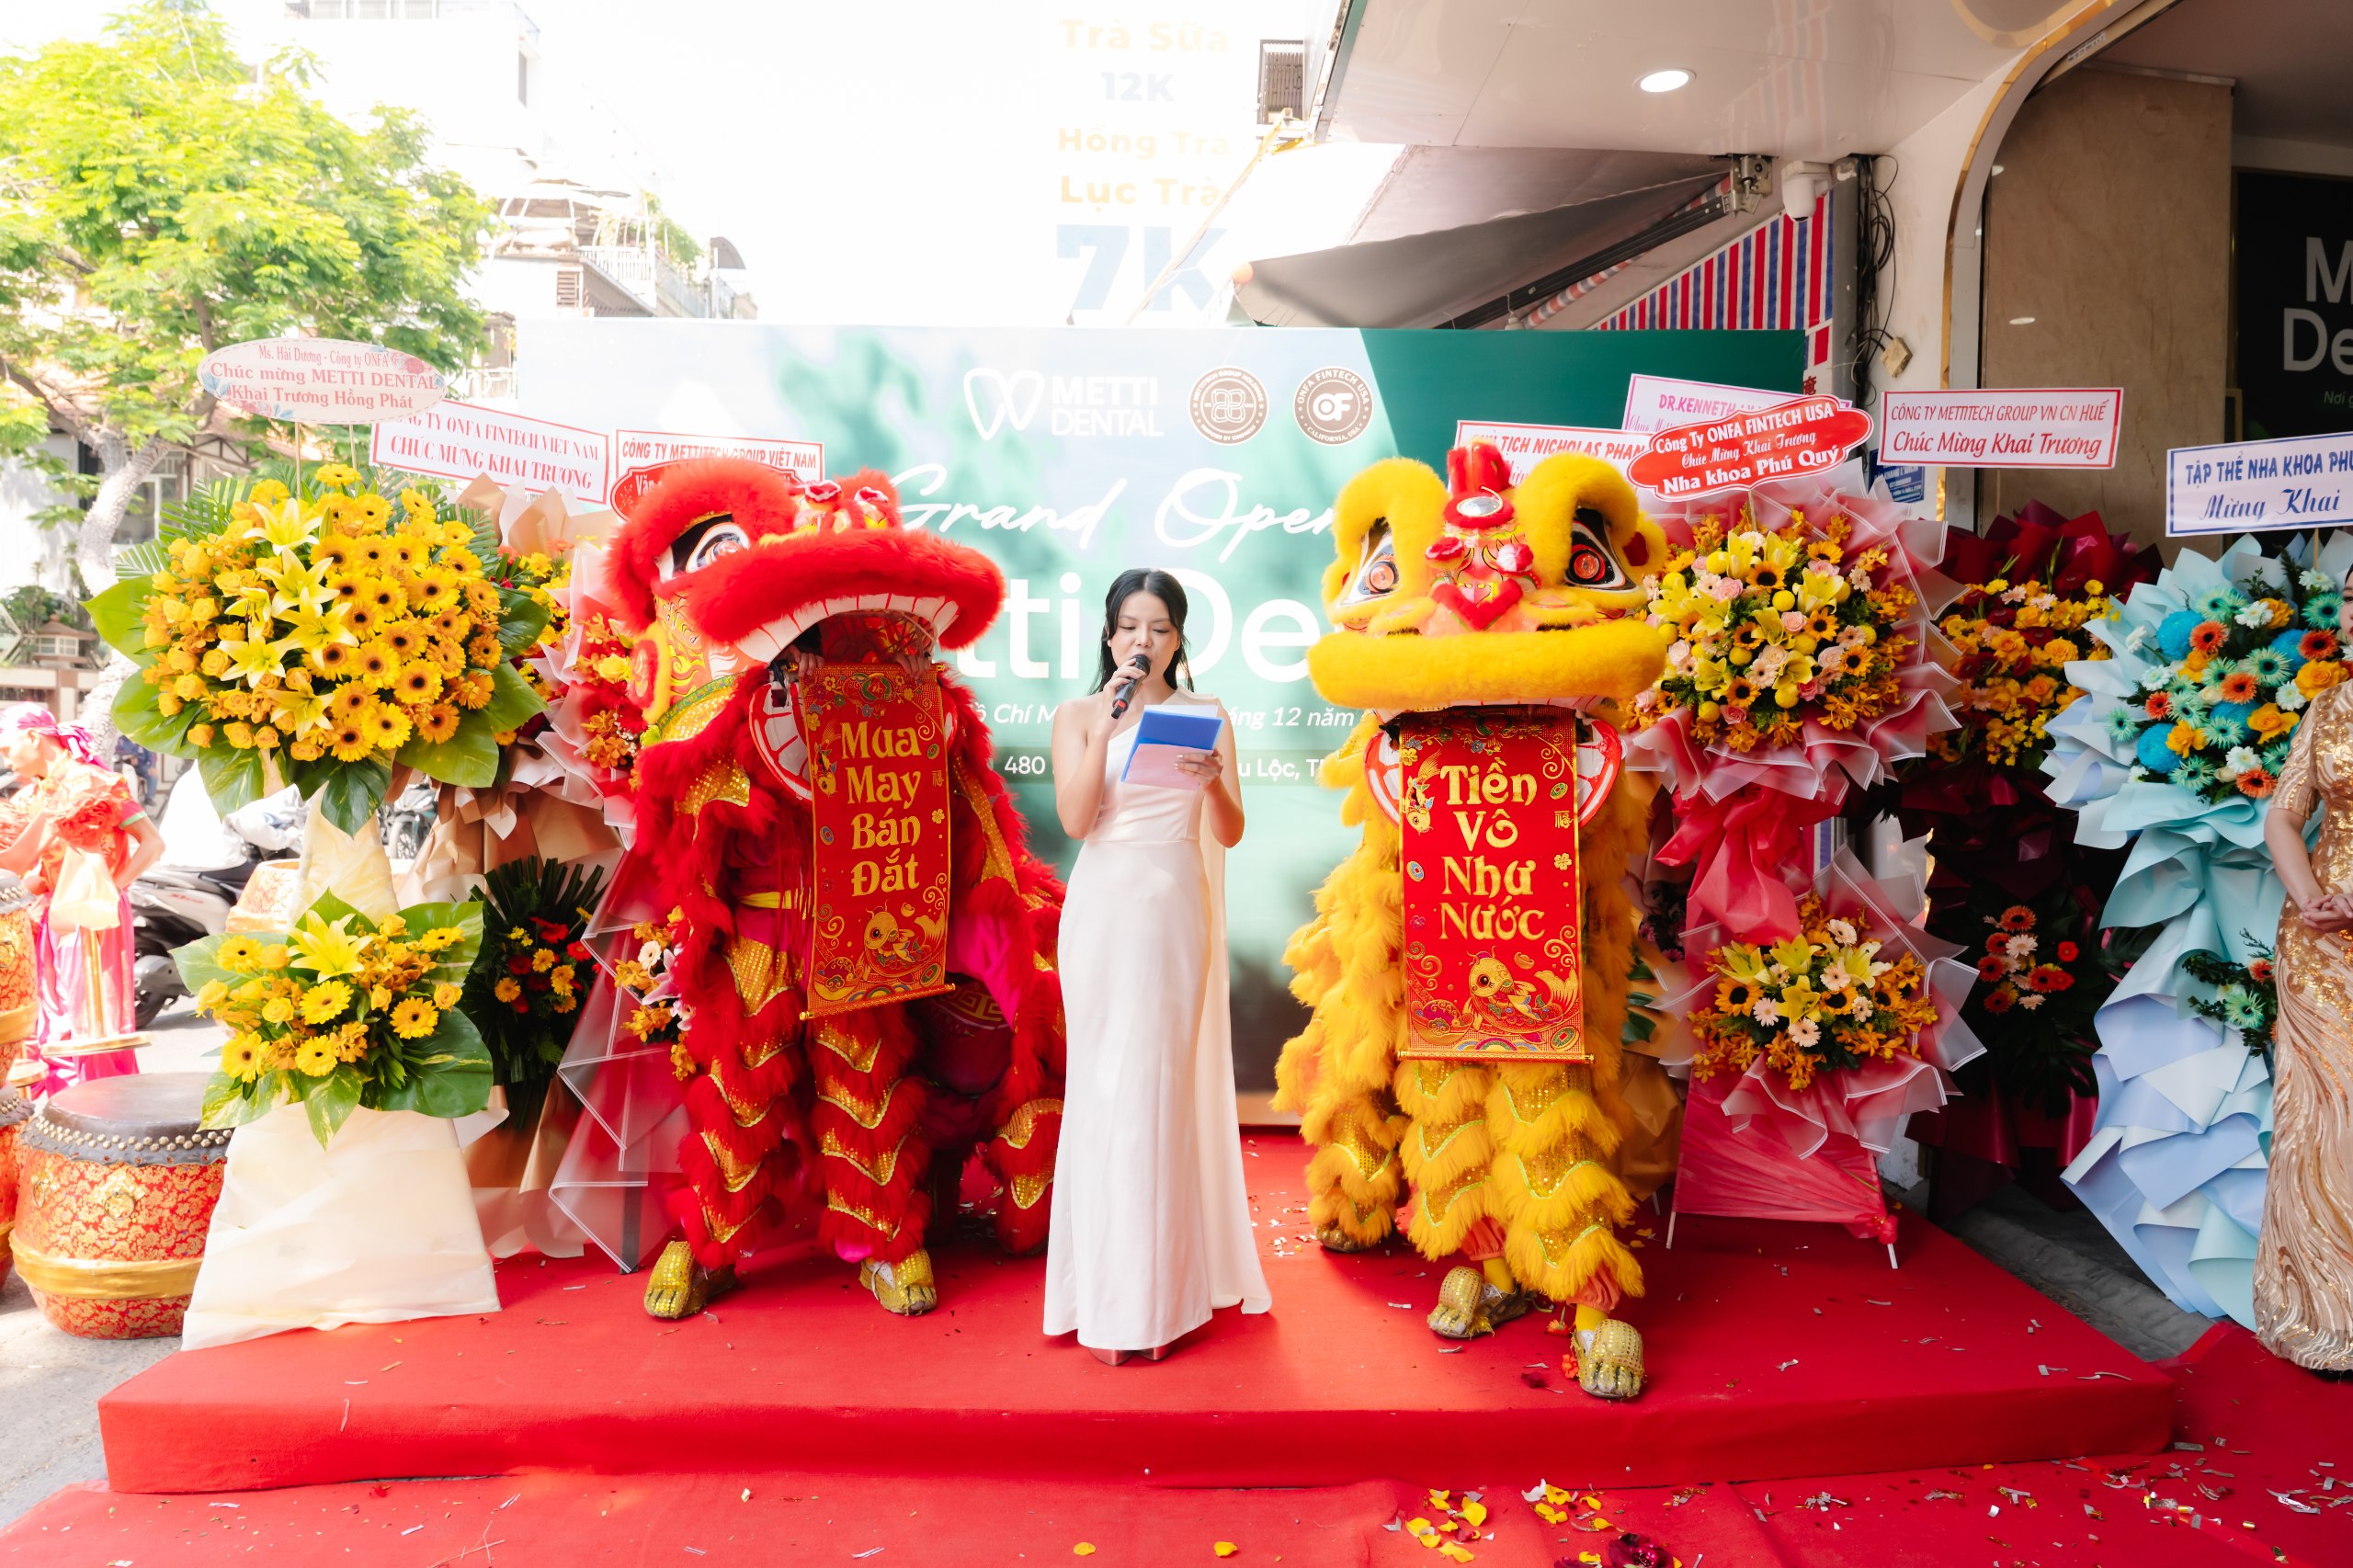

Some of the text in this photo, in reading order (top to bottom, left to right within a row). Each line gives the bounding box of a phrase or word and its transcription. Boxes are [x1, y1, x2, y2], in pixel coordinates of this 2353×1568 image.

[1059, 17, 1229, 52] Trà Sữa
[1101, 71, 1176, 102] 12K
[1172, 131, 1229, 155] Trà
[1061, 176, 1222, 212] Lục Trà
[1057, 223, 1229, 312] 7K
[258, 345, 274, 360] Ms.
[294, 347, 322, 366] Dương
[330, 349, 352, 368] Công
[354, 353, 362, 369] ty
[364, 352, 389, 368] ONFA
[210, 362, 438, 391] Chúc mừng METTI DENTAL
[1051, 376, 1158, 405] METTI
[1297, 369, 1370, 404] ONFA FINTECH USA
[231, 384, 413, 410] Khai Trương Hồng Phát
[1891, 399, 2109, 423] CÔNG TY METTITECH GROUP VN CN HUẾ
[426, 412, 440, 430] TY
[447, 416, 481, 438] ONFA
[485, 424, 538, 449] FINTECH
[542, 435, 569, 456] VIỆT
[573, 444, 598, 461] NAM
[1051, 408, 1165, 437] DENTAL
[1655, 402, 1835, 454] Công Ty ONFA FINTECH USA
[391, 434, 592, 490] CHÚC MỪNG KHAI TRƯƠNG
[622, 437, 651, 459] CÔNG
[655, 443, 667, 460] TY
[768, 447, 791, 467] VIỆT
[793, 453, 816, 469] NAM
[1501, 436, 1530, 456] TỊCH
[1532, 437, 1602, 458] NICHOLAS
[1681, 430, 1816, 469] Chúc Mừng Khai Trương
[1893, 430, 2103, 460] Chúc Mừng Khai Trương
[1663, 444, 1840, 494] Nha khoa Phú Quý
[2186, 460, 2211, 489] TẬP
[2216, 450, 2243, 482] THỂ
[2247, 457, 2278, 480] NHA
[2282, 452, 2323, 478] KHOA
[889, 463, 1127, 550] Grand
[2200, 488, 2341, 522] Mừng Khai
[994, 703, 1034, 724] Chí
[1229, 706, 1266, 730] áng
[1272, 707, 1302, 727] 12
[1307, 708, 1355, 727] năm
[840, 720, 922, 760] Mua
[1005, 756, 1046, 775] 480
[1256, 758, 1300, 781] Lộc,
[1439, 756, 1538, 807] Tiền
[845, 766, 922, 810] May
[851, 806, 922, 850] Bán
[1452, 808, 1518, 853] Vô
[850, 848, 920, 898] Đắt
[1441, 855, 1537, 899] Như
[1438, 895, 1546, 941] Nước
